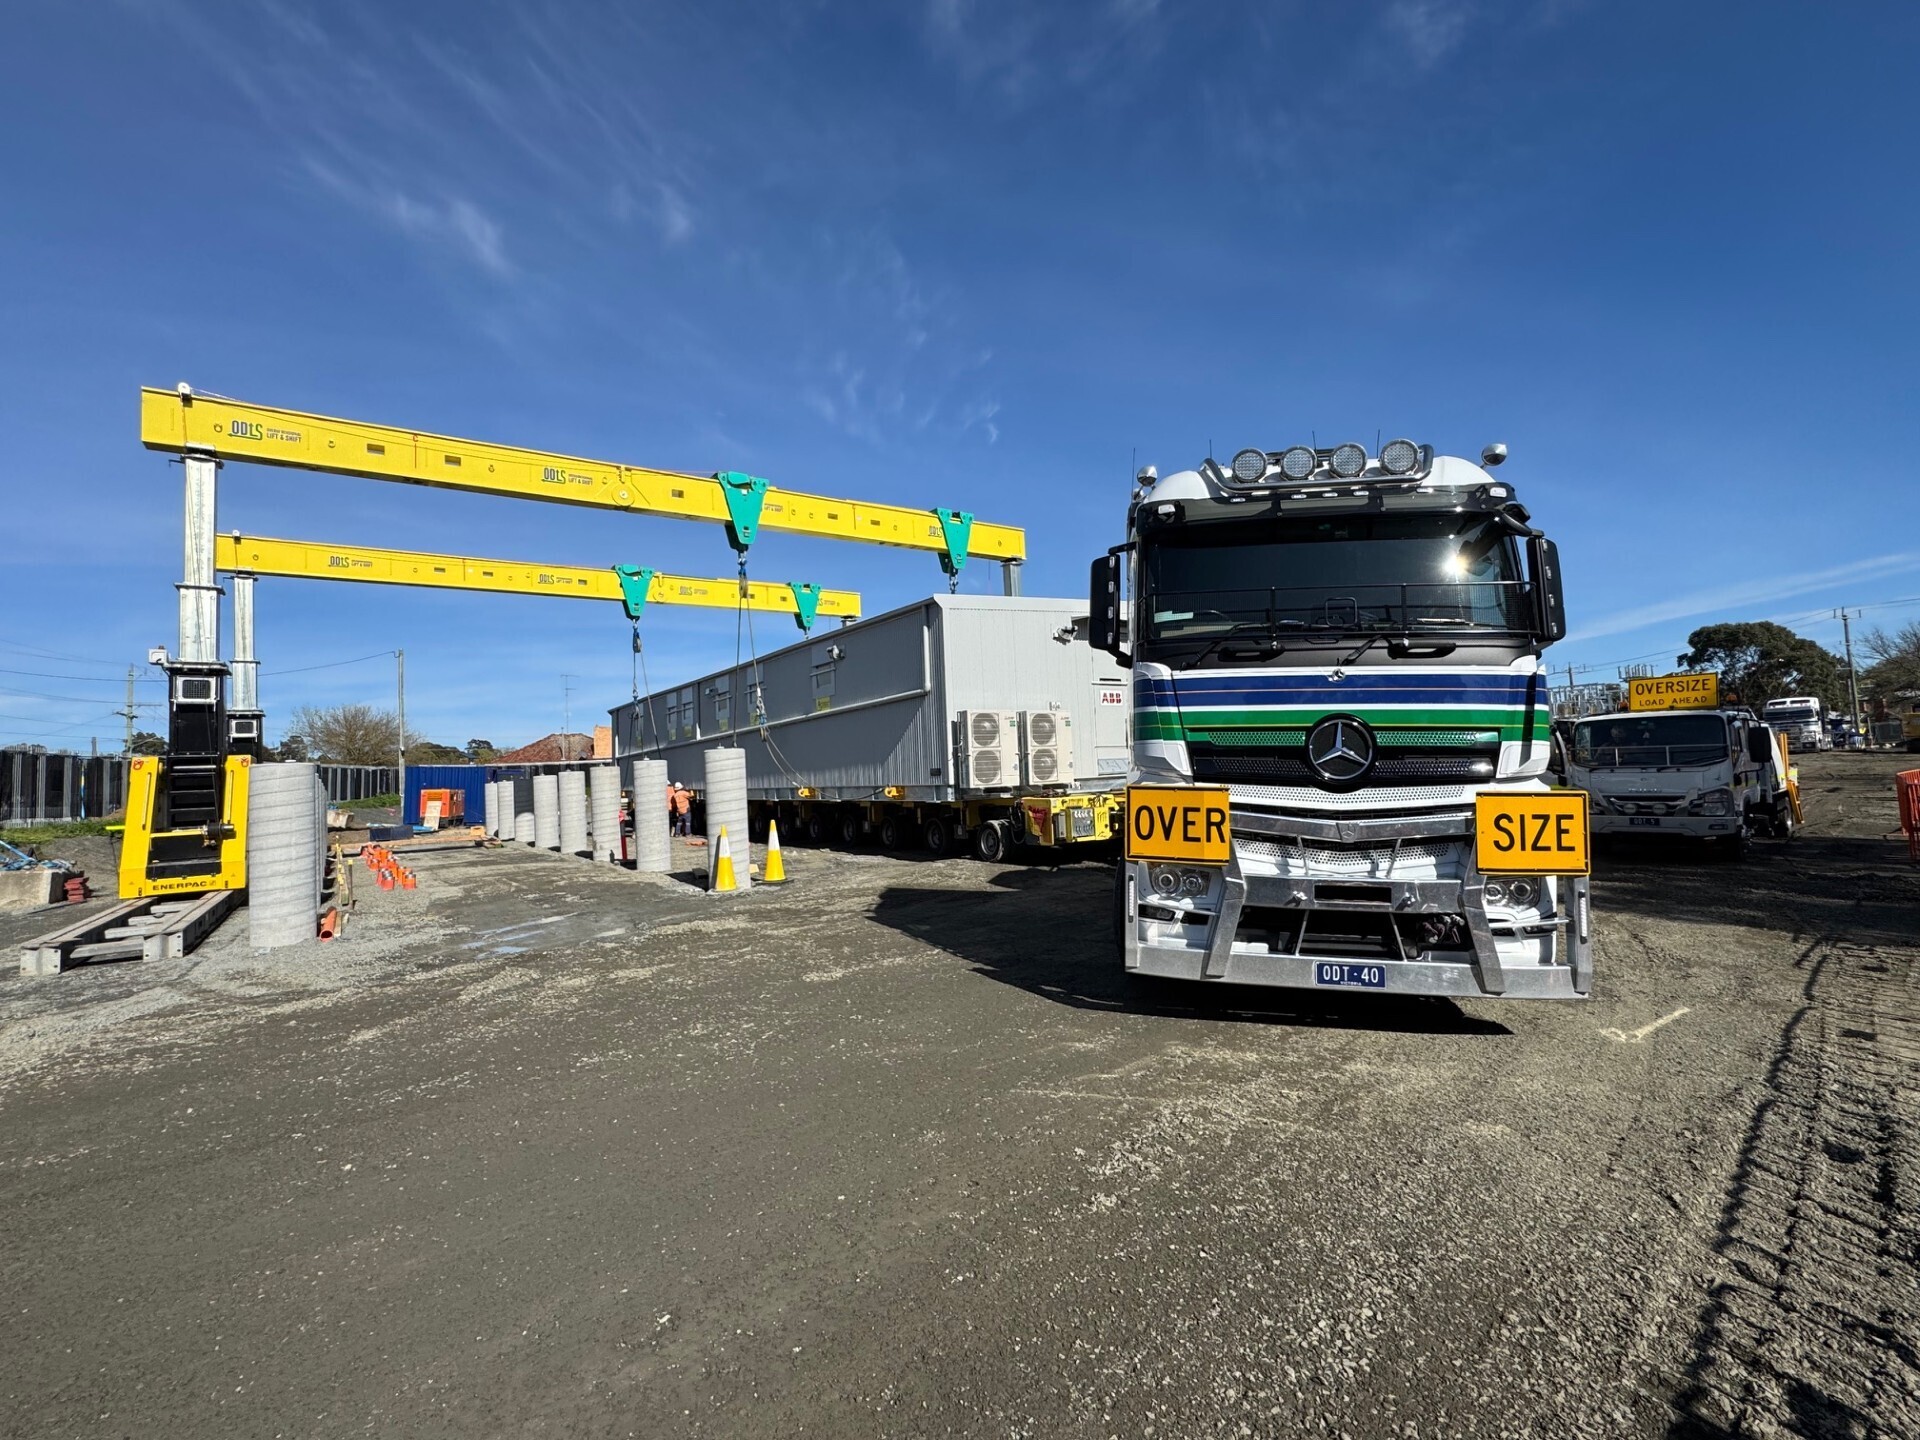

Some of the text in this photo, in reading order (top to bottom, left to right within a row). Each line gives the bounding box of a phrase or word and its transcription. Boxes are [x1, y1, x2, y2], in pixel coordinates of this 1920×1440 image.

[1635, 679, 1711, 695] OVERSIZE
[1101, 692, 1122, 704] ABB
[1639, 695, 1707, 706] LOAD AHEAD
[1134, 804, 1576, 852] OVER SIZE
[152, 880, 207, 891] ENERPAC
